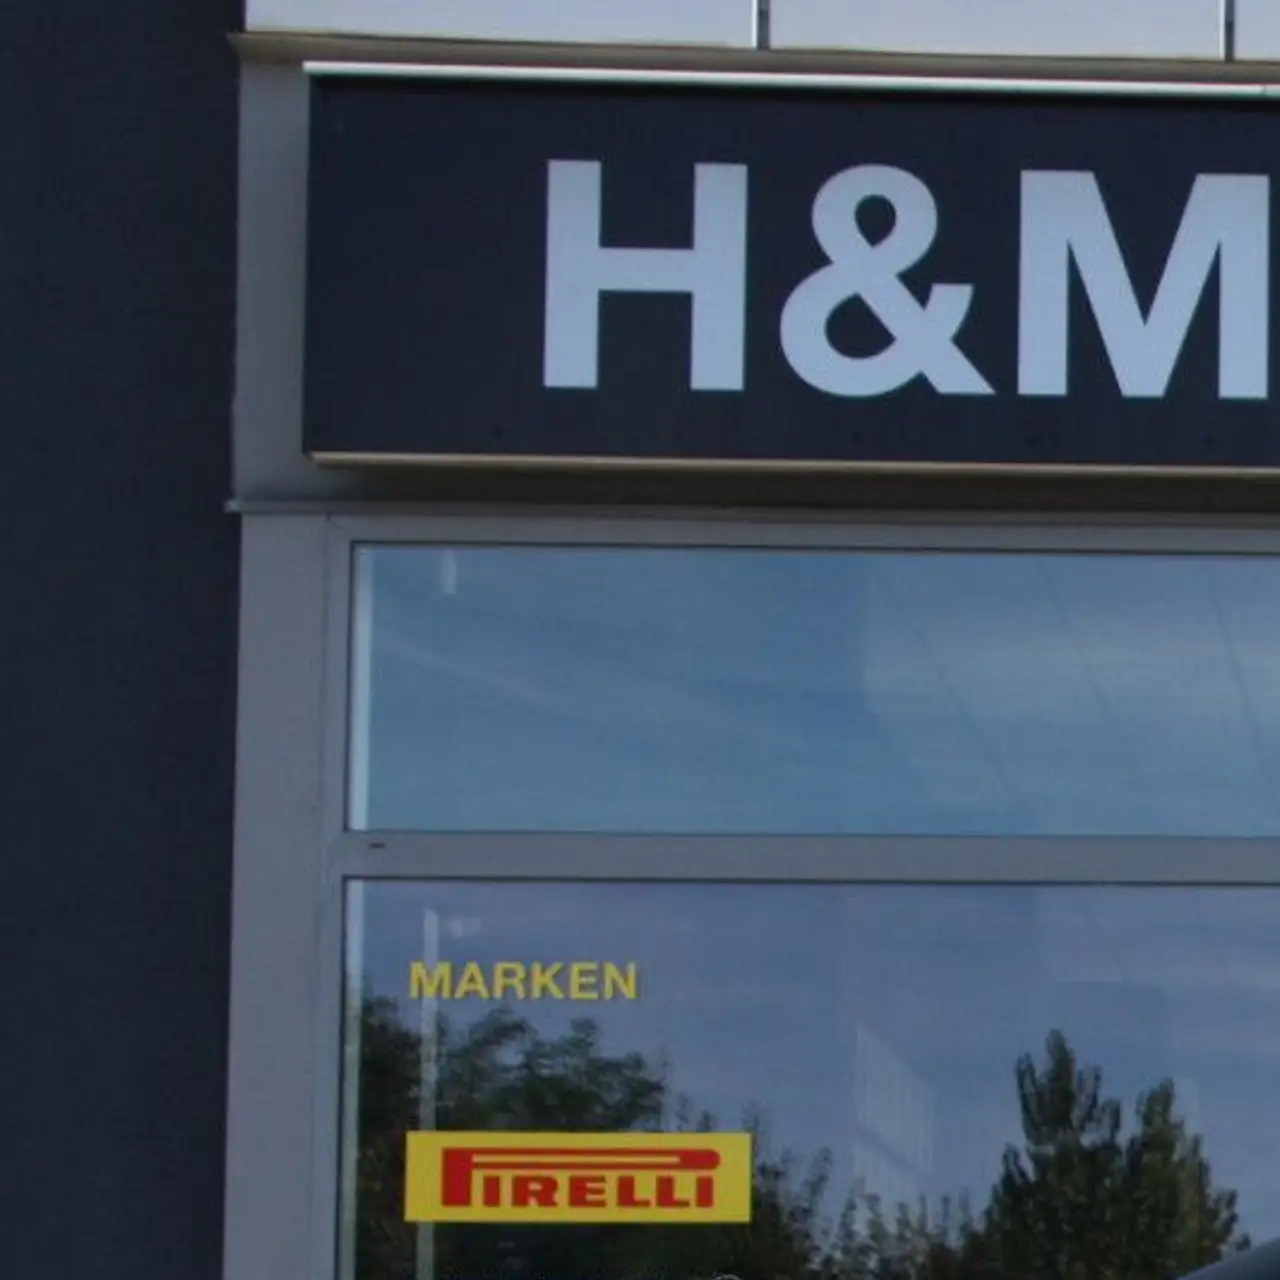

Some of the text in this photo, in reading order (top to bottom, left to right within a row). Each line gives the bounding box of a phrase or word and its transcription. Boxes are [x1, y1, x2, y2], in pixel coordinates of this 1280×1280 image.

[543, 158, 1270, 400] H&M
[408, 960, 639, 1001] MARKEN
[441, 1146, 722, 1209] PIRELLI
